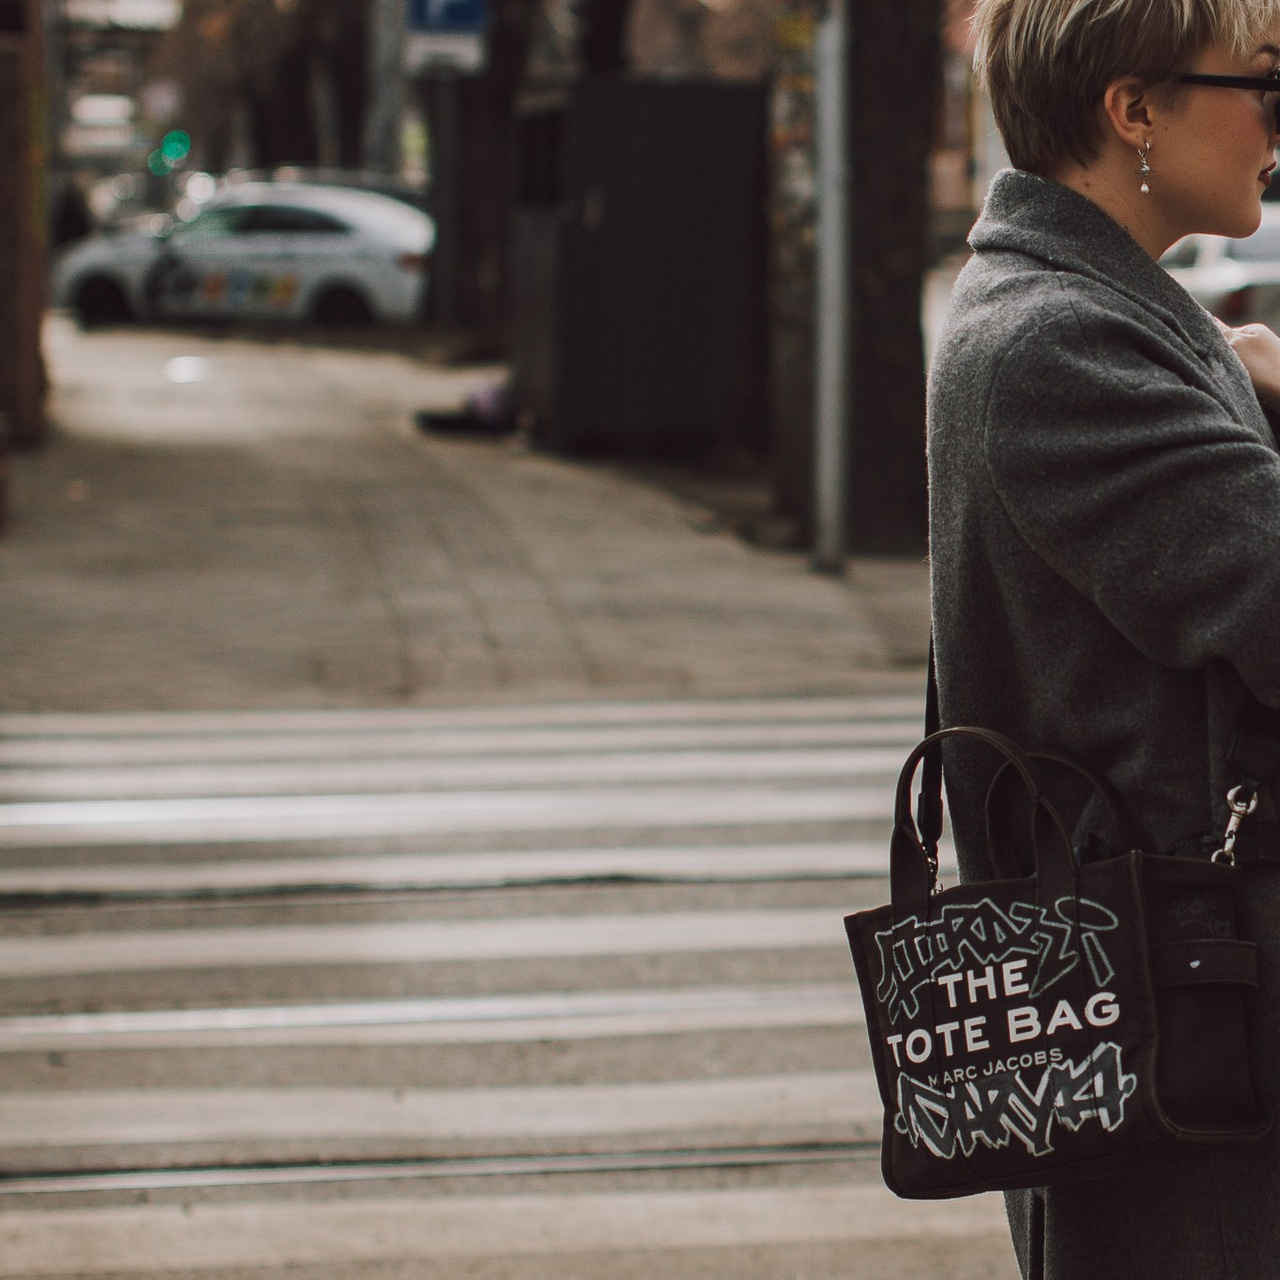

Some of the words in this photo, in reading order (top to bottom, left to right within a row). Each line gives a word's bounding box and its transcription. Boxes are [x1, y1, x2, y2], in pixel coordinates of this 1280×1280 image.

[938, 959, 1030, 1009] THE
[887, 1015, 991, 1068] TOTE
[1007, 991, 1121, 1043] BAG
[983, 1047, 1064, 1074] JACOBS
